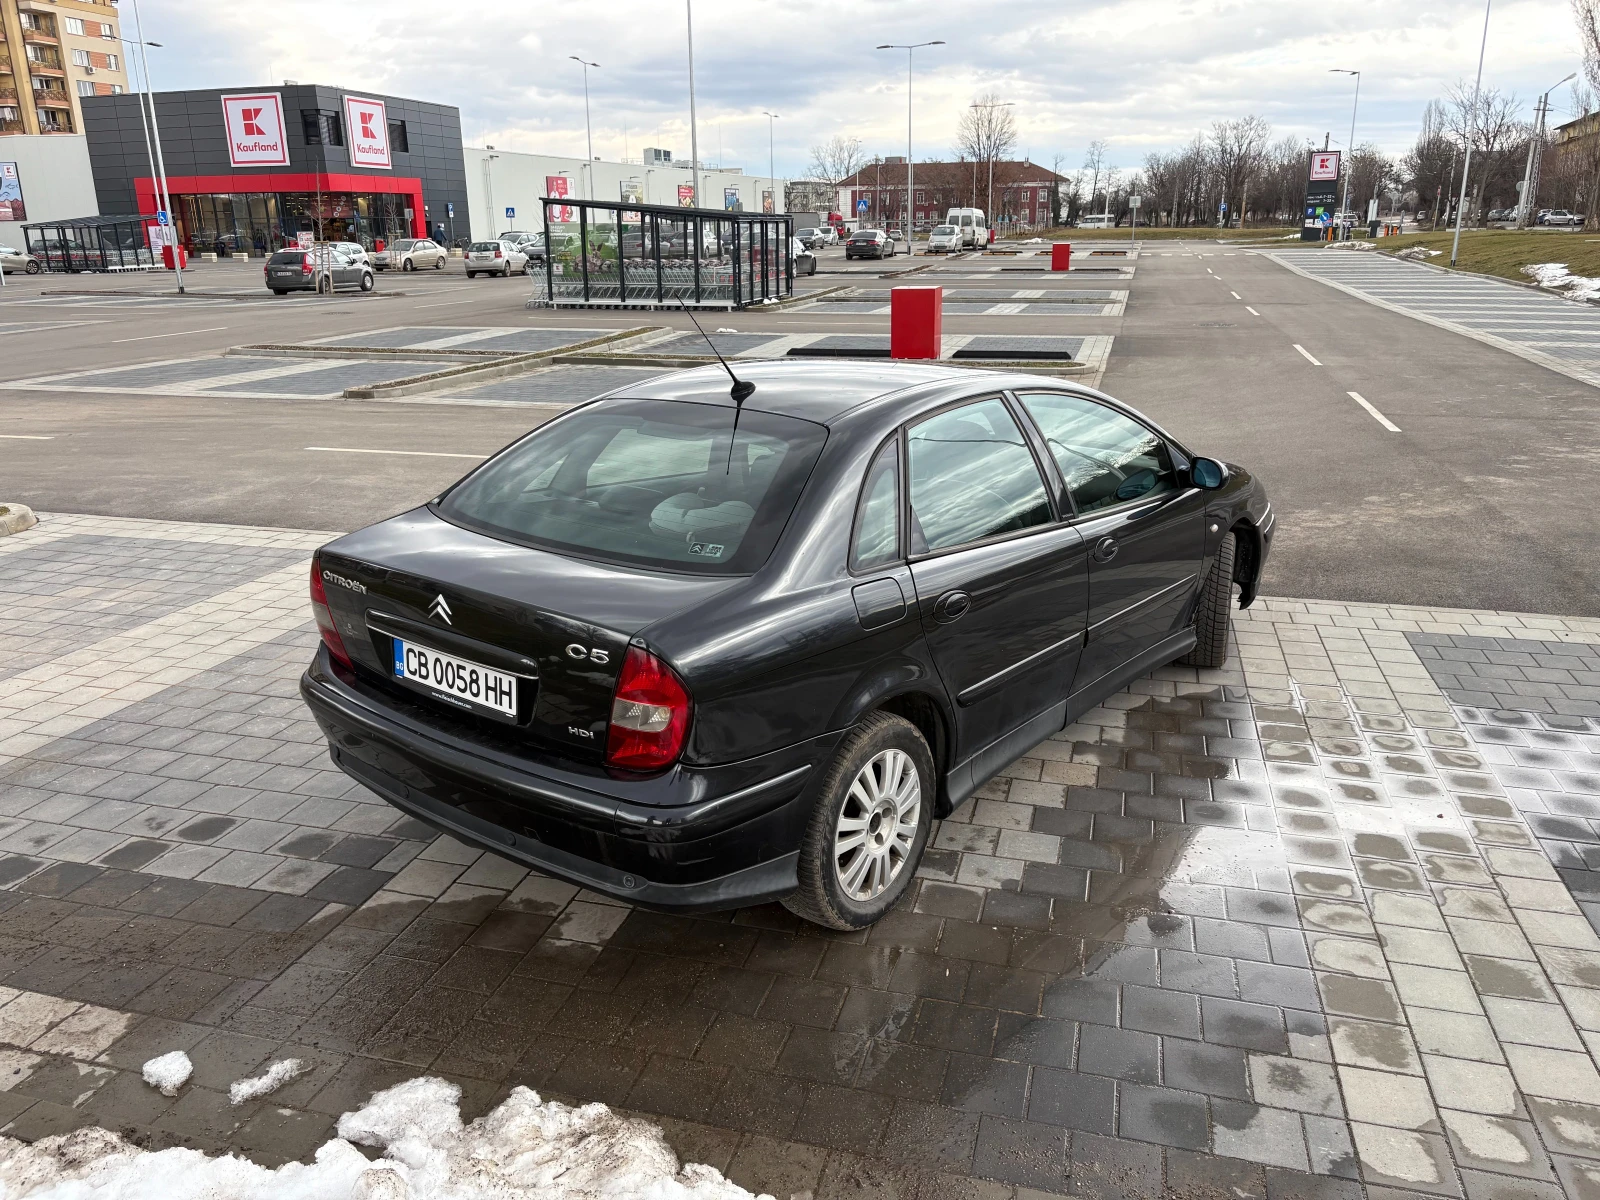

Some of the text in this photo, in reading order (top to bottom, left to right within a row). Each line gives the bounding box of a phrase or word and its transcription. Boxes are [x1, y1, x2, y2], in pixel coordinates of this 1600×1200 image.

[236, 141, 278, 153] Kaufland
[356, 143, 385, 155] Kaufland
[322, 570, 368, 595] CITROËN
[565, 643, 609, 664] C5
[395, 660, 404, 671] BG
[406, 647, 430, 681] CB
[433, 656, 481, 698] 0058
[484, 672, 513, 710] HH
